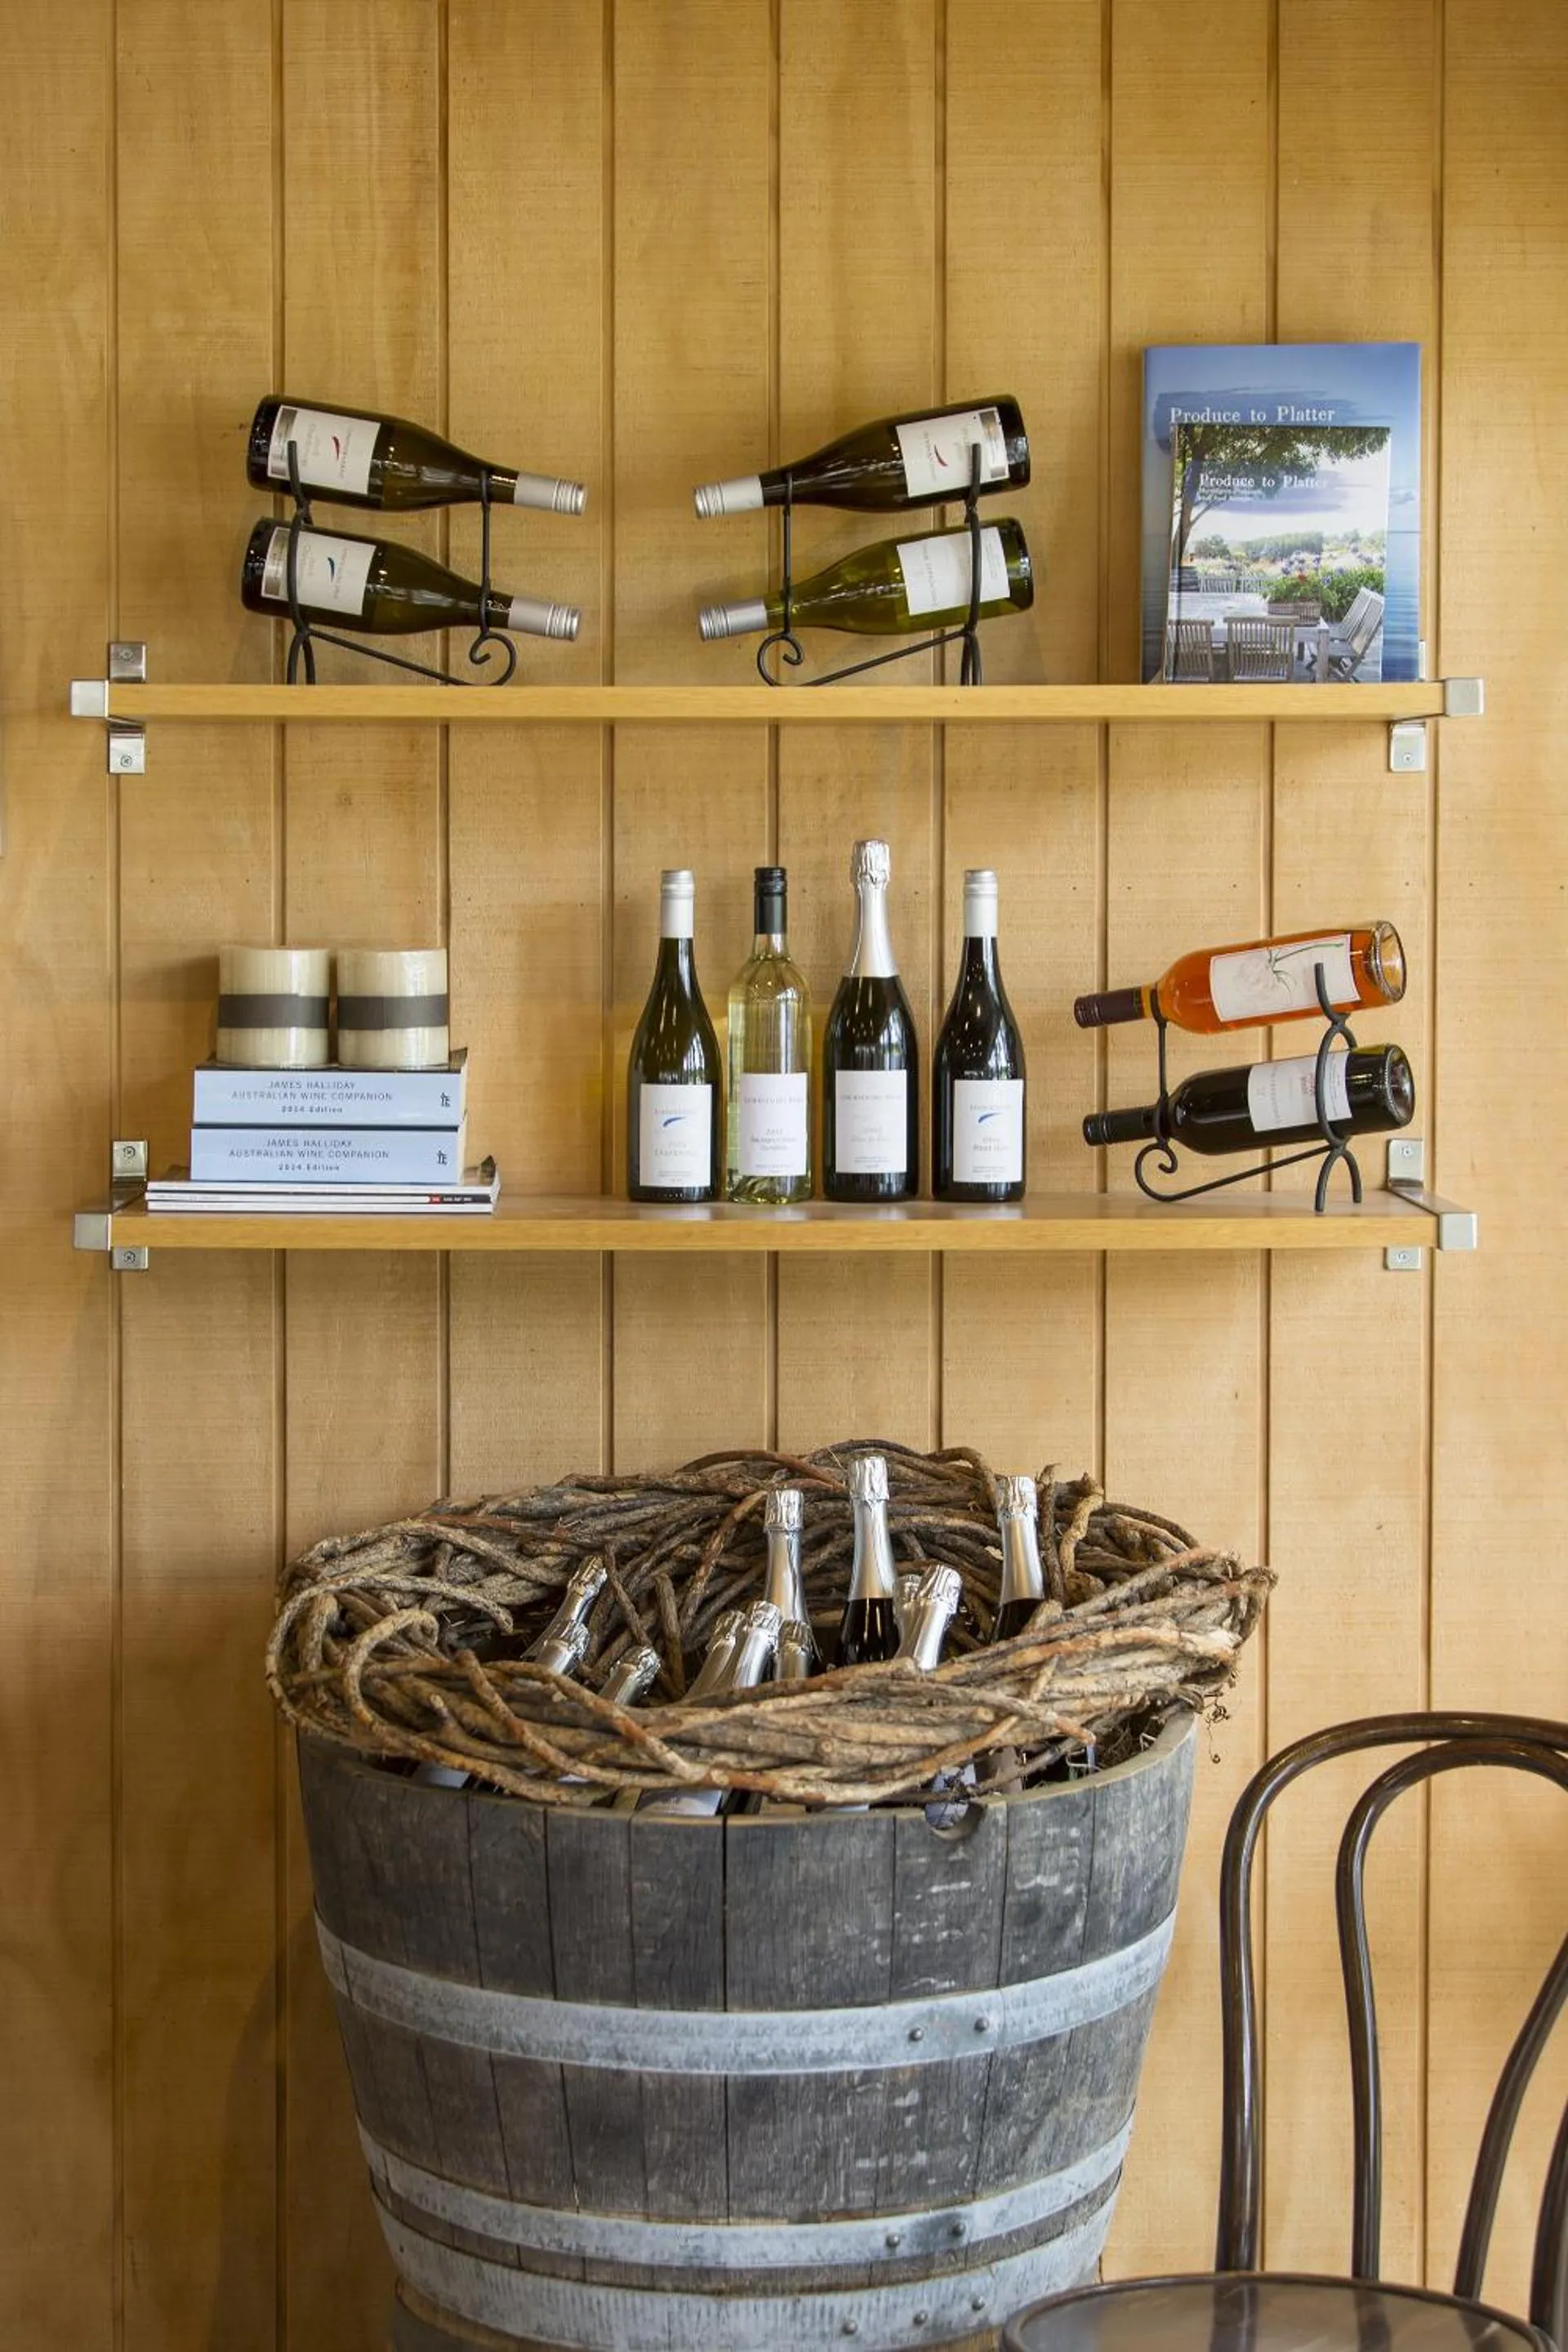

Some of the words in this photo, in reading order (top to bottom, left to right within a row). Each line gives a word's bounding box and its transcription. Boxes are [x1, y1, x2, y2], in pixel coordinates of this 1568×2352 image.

[1169, 407, 1241, 423] Produce
[1250, 408, 1266, 423] to
[1276, 405, 1335, 422] Platter
[1200, 473, 1255, 488] Produce
[1262, 475, 1276, 488] to
[269, 1080, 301, 1089] JAMES
[305, 1080, 355, 1089] HALLIDAY
[230, 1091, 296, 1100] AUSTRALIAN
[301, 1092, 327, 1100] WINE
[331, 1093, 392, 1101] COMPANION
[266, 1138, 299, 1147] JAMES
[303, 1139, 352, 1148] HALLIDAY
[229, 1148, 293, 1158] AUSTRALIAN
[298, 1150, 324, 1158] WINE
[327, 1150, 390, 1159] COMPANION
